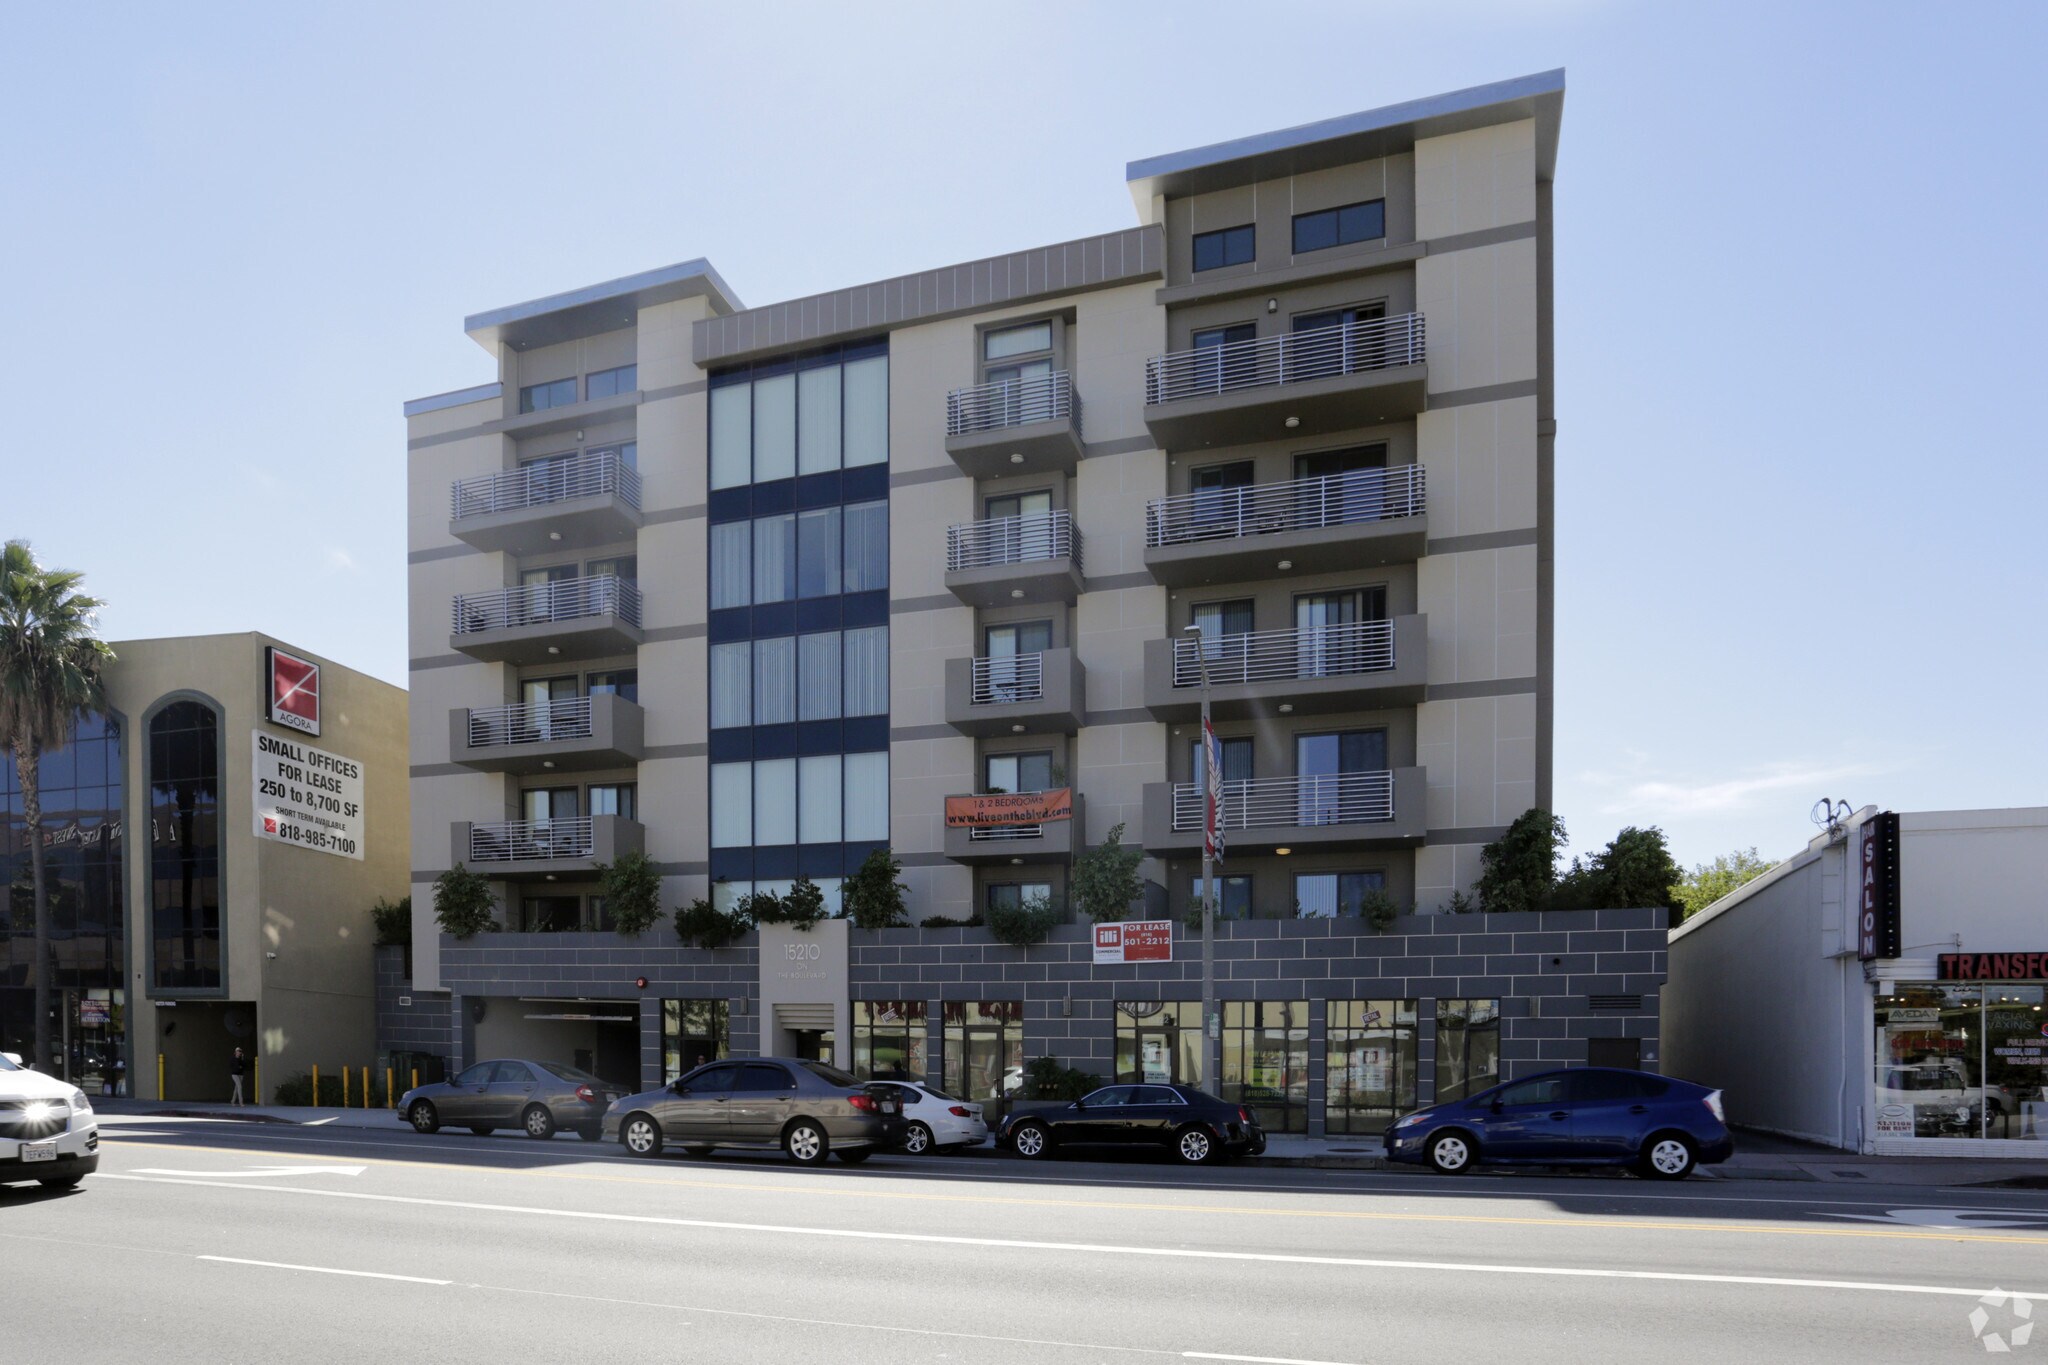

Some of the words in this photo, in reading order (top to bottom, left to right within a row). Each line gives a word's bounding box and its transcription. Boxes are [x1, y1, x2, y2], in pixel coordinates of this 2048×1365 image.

[280, 712, 312, 730] AGORA
[259, 736, 304, 763] SMALL
[308, 751, 358, 779] OFFICES
[278, 762, 302, 783] FOR
[306, 771, 342, 794] LEASE
[260, 778, 286, 799] 250
[290, 787, 303, 803] to
[306, 791, 340, 815] 8,700
[344, 802, 358, 818] SF
[979, 800, 985, 808] &
[995, 797, 1044, 807] BEDROOMS
[275, 806, 296, 819] SHORT
[297, 811, 314, 823] TERM
[315, 816, 346, 831] AVAILABLE
[948, 807, 1072, 823] www.liveontheblvd.com
[280, 823, 356, 854] 818-985-7100
[1863, 842, 1874, 955] SALON
[1144, 923, 1170, 931] LEASE
[1124, 937, 1170, 945] 501-2212
[784, 943, 820, 960] 15210
[1892, 1010, 1930, 1018] AVEDA
